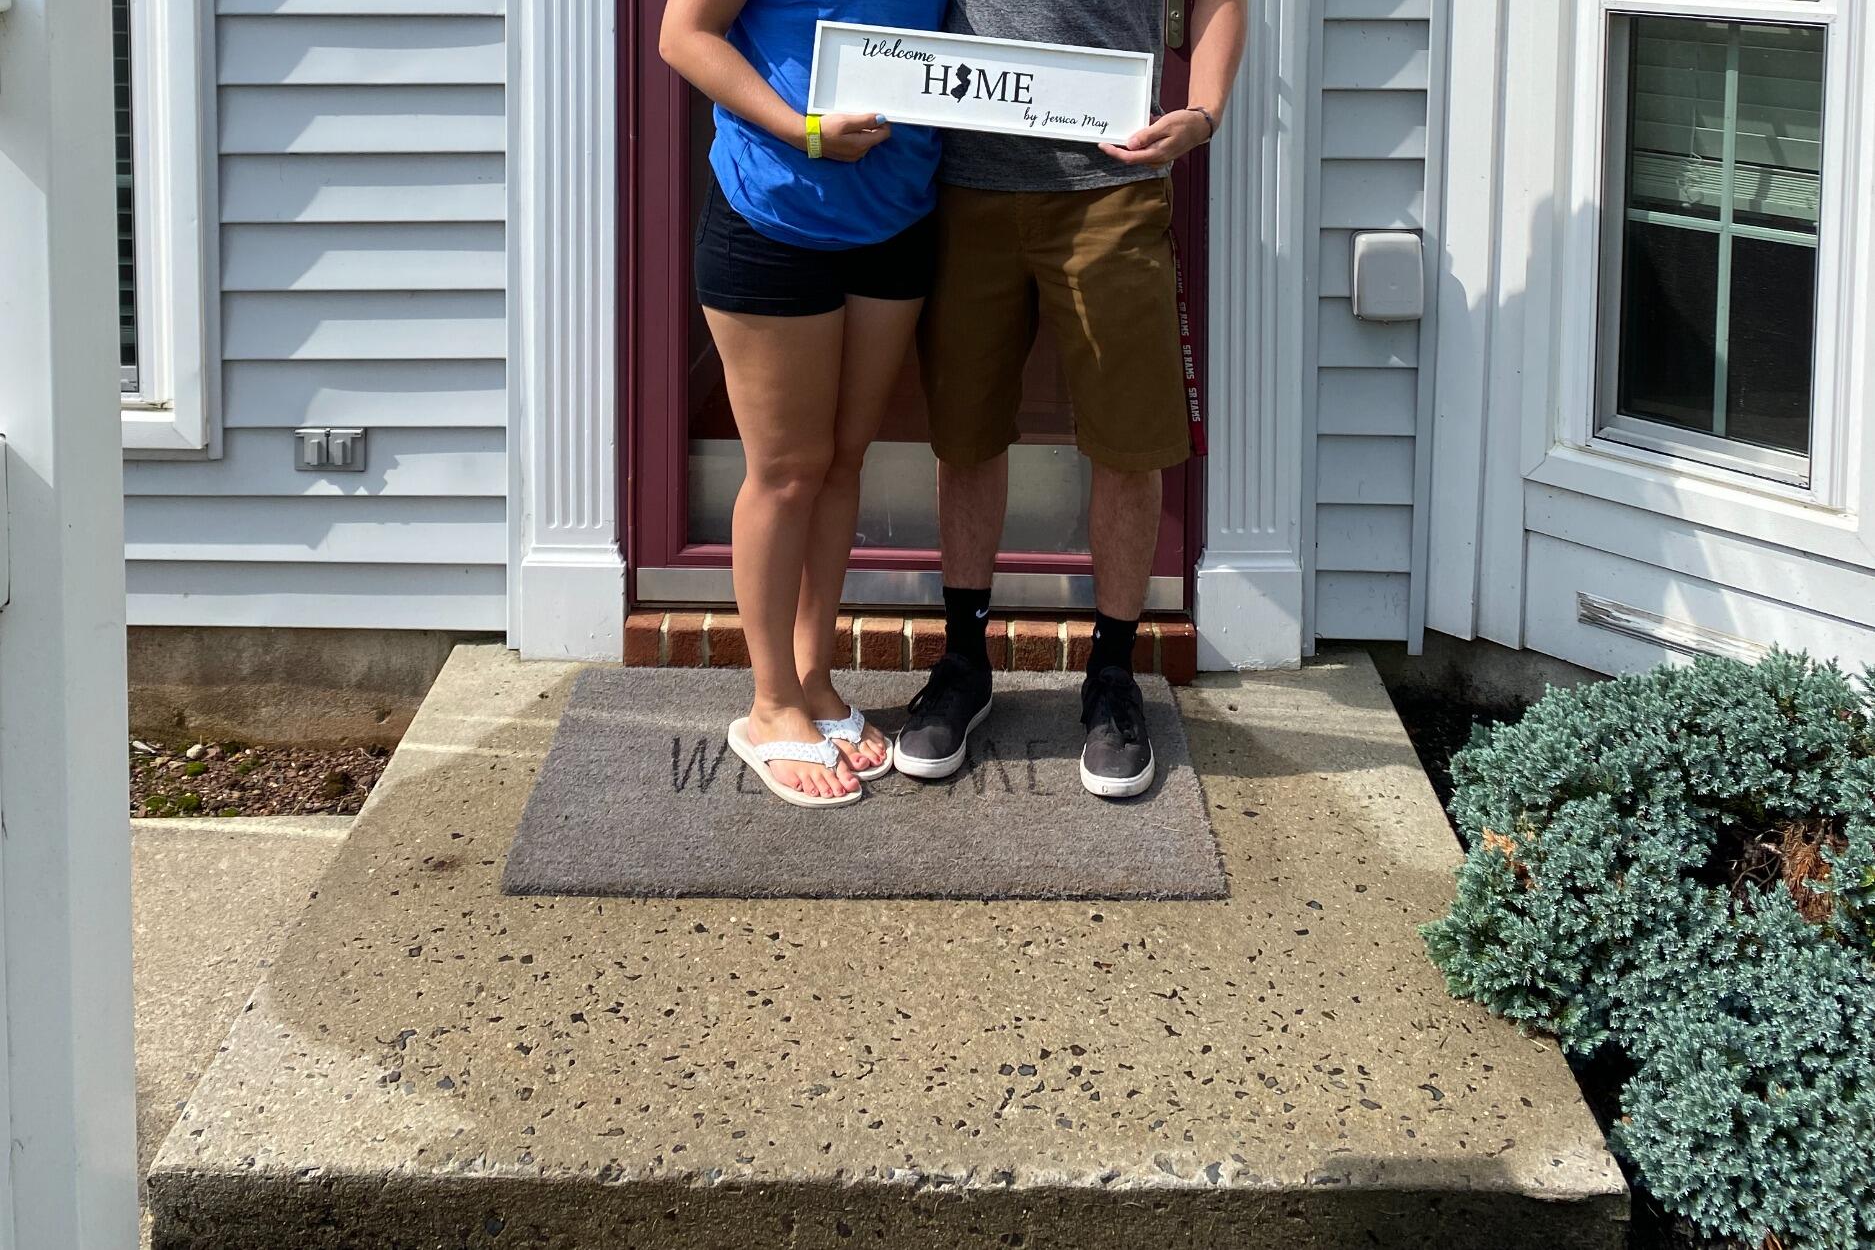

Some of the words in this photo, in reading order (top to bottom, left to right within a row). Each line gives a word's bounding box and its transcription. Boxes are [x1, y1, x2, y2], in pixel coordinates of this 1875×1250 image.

[862, 37, 937, 63] Welcome
[921, 62, 1035, 105] HME
[1023, 106, 1038, 128] by
[1041, 110, 1079, 127] Jessica
[1081, 113, 1110, 135] May
[1183, 344, 1192, 355] SR
[1184, 356, 1195, 380] RAMS
[1189, 387, 1198, 398] SR
[1190, 399, 1201, 422] RAMS
[672, 736, 1056, 796] WEME
